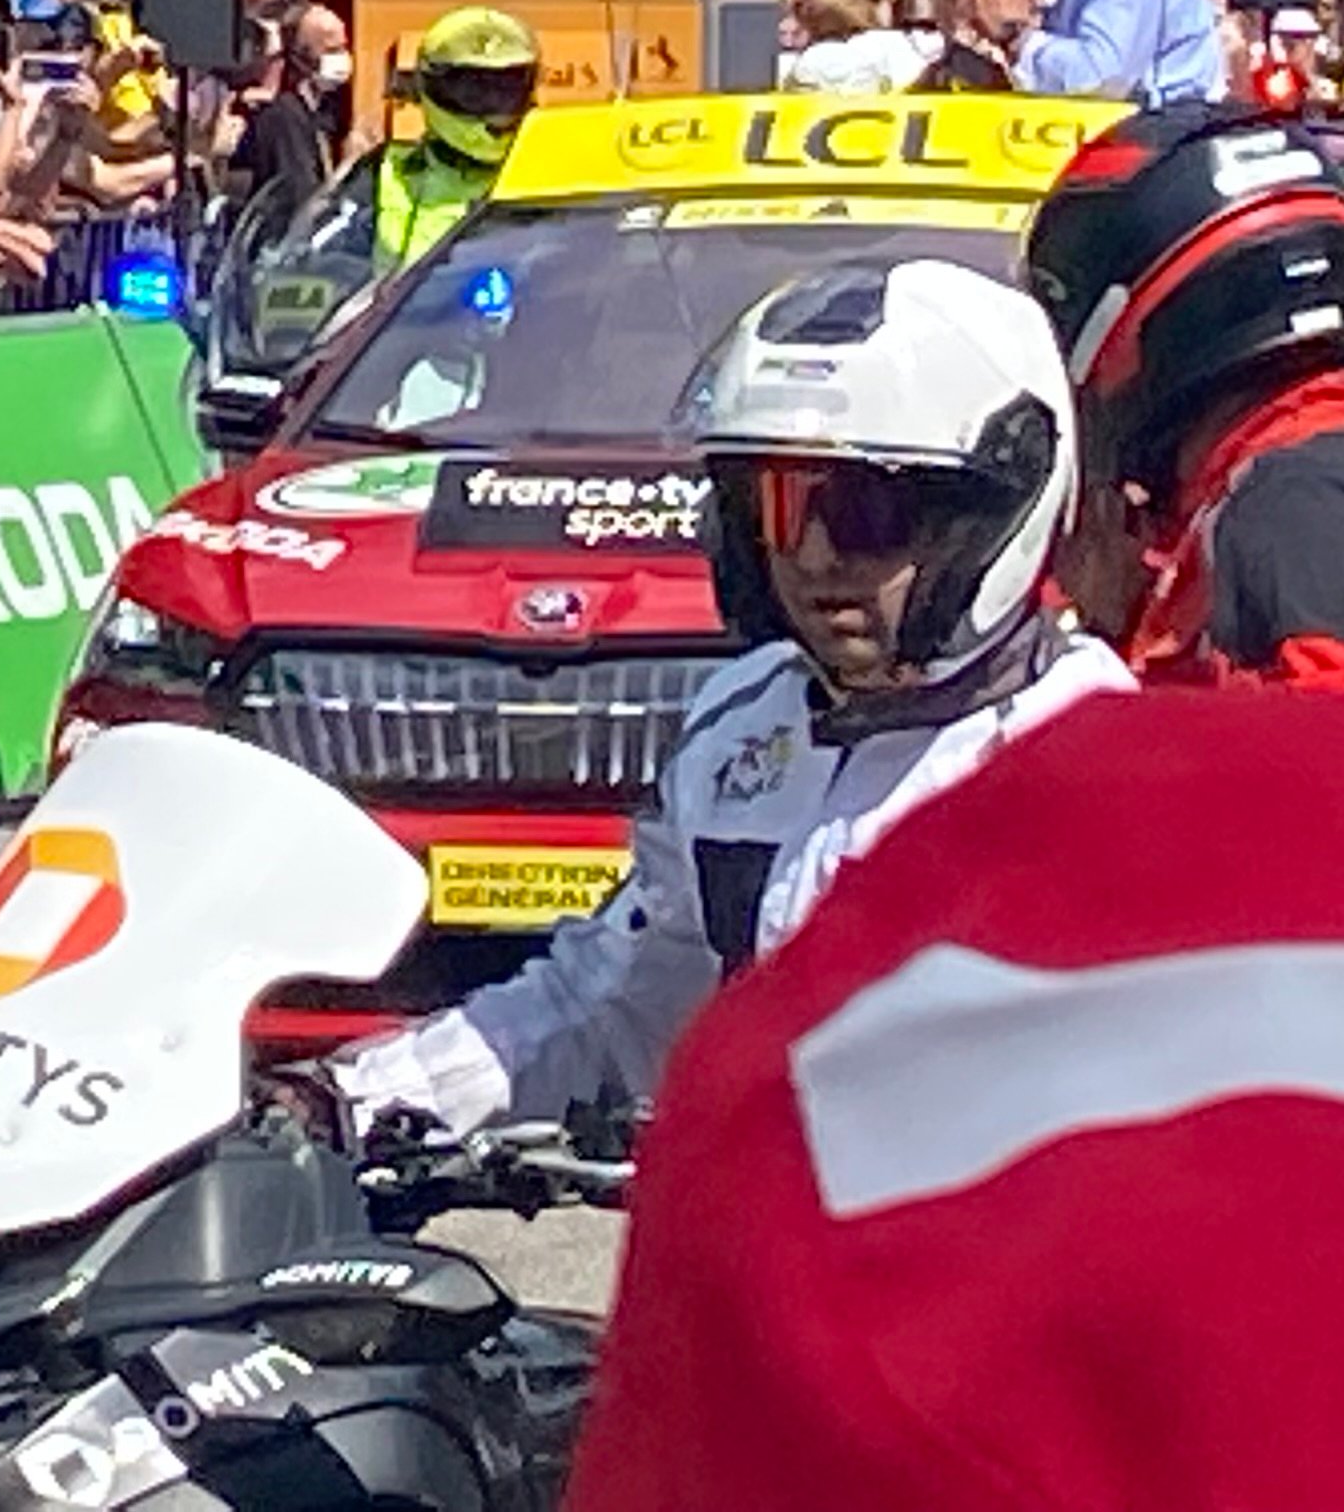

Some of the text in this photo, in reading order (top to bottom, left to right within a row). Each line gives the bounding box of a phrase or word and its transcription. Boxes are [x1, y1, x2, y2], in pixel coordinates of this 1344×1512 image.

[627, 117, 712, 148] LCL
[742, 110, 971, 169] LCL
[565, 508, 700, 546] sport
